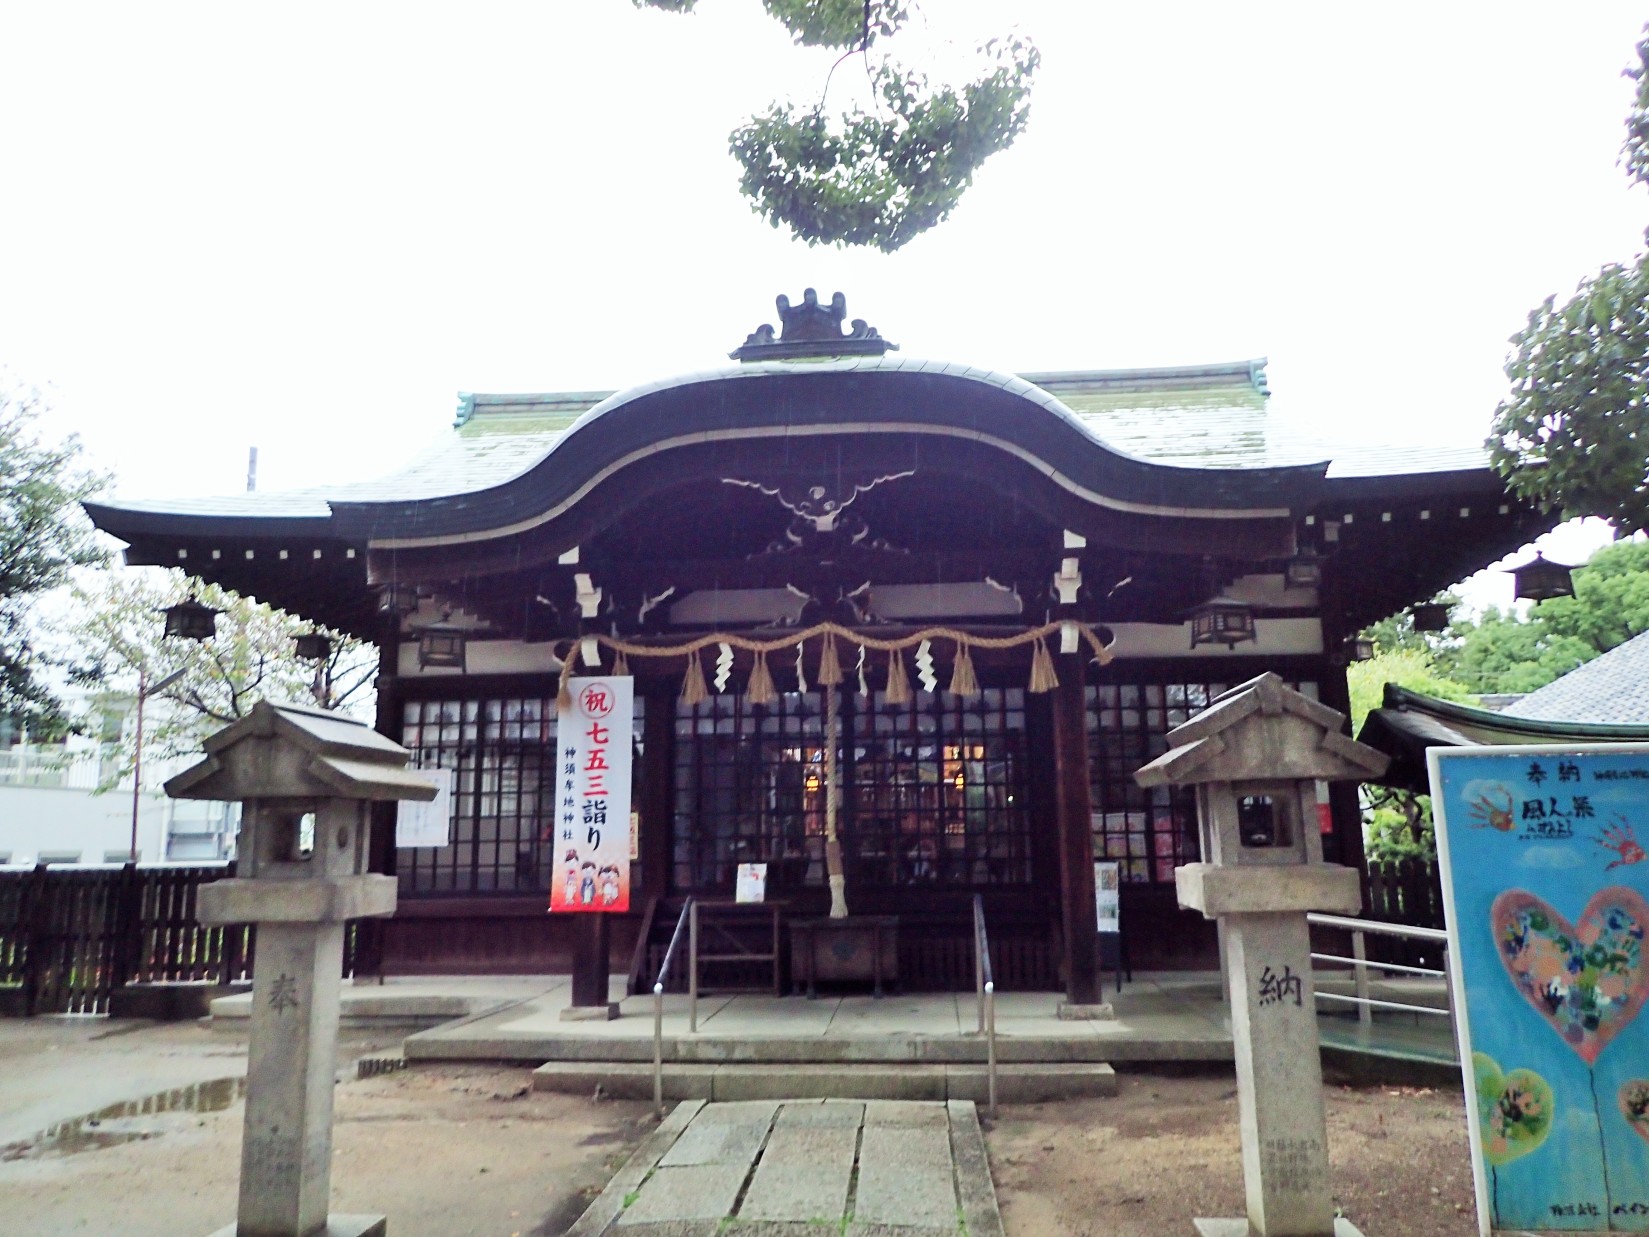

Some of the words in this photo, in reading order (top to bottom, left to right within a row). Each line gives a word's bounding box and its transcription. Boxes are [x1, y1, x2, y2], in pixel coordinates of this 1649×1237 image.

[585, 689, 609, 714] 祝
[562, 746, 577, 841] 神須牟地神社
[583, 722, 609, 851] 七五三詣り
[268, 973, 299, 1016] 奉
[1259, 965, 1302, 1006] 納
